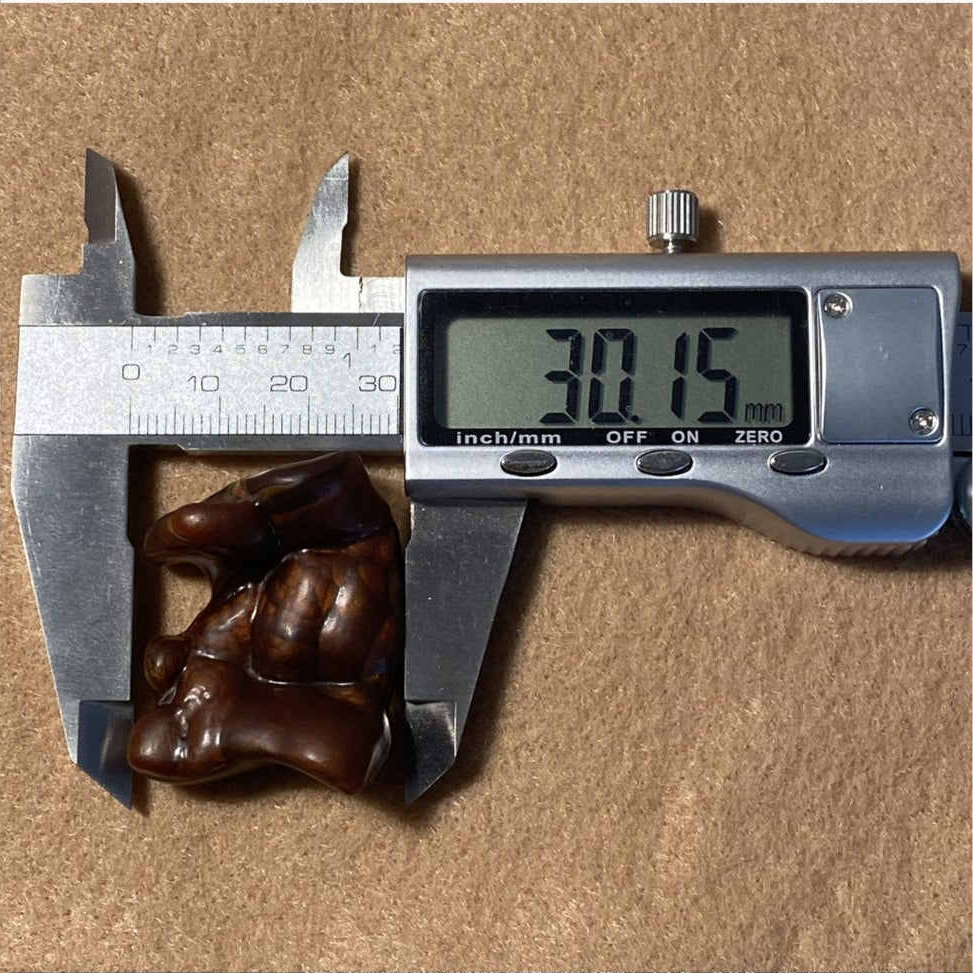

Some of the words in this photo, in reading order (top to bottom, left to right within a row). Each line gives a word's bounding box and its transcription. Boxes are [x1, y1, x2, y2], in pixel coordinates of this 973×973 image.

[122, 364, 140, 380] 0
[187, 376, 219, 392] 10
[269, 376, 307, 392] 20
[343, 353, 351, 368] 1
[359, 376, 396, 392] 30
[539, 327, 739, 423] 30.15
[746, 403, 784, 423] mm
[456, 431, 562, 444] inch/mm
[606, 431, 647, 444] OFF
[672, 431, 699, 444] ON
[735, 431, 783, 444] ZERO
